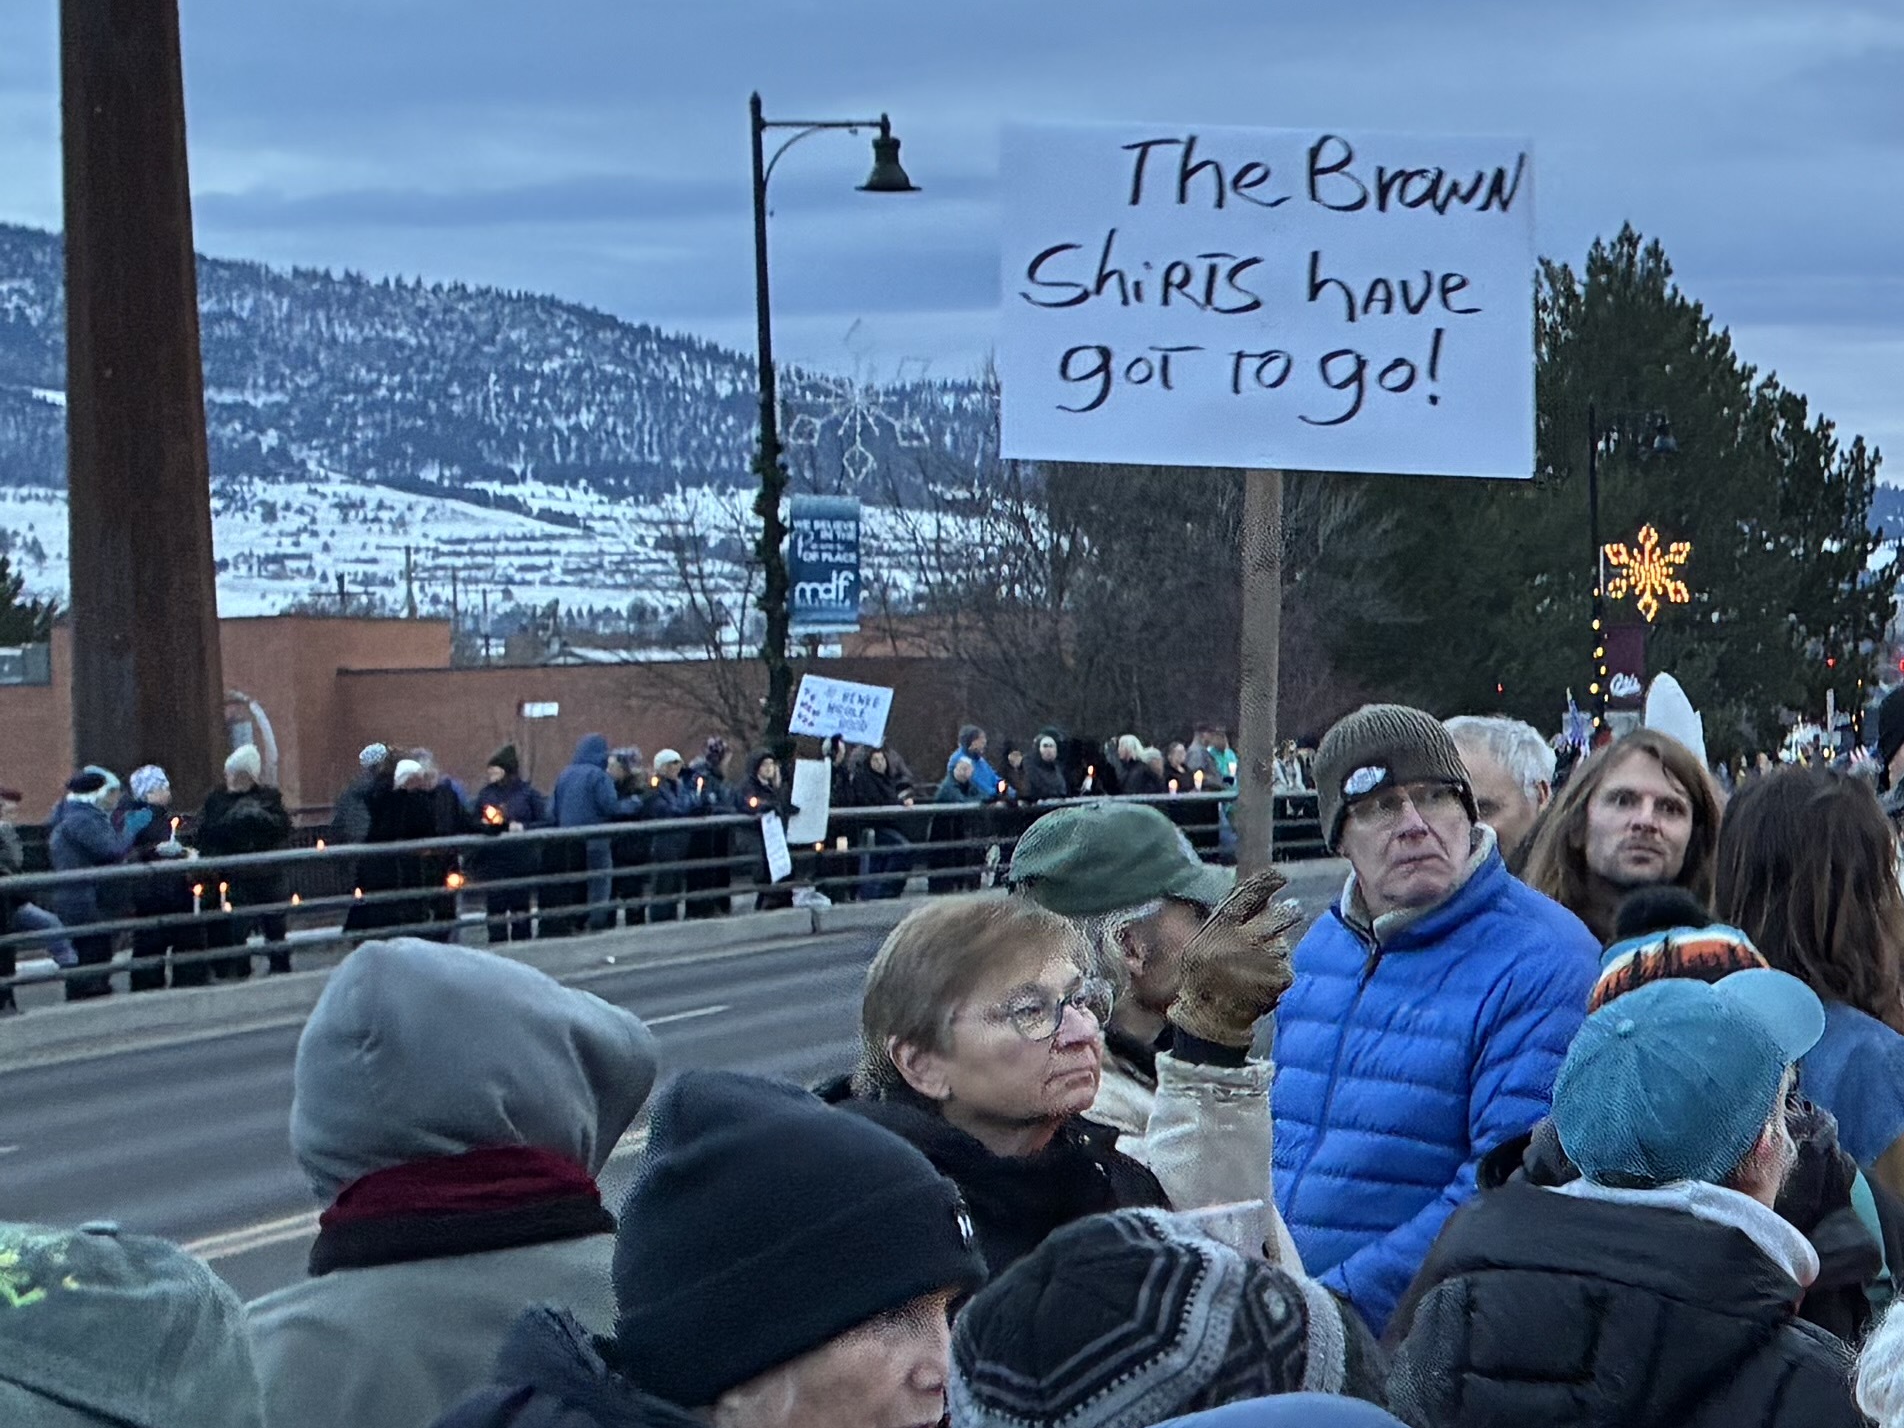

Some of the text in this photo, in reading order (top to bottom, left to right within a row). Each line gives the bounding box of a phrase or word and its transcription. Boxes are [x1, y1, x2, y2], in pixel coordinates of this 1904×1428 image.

[1121, 134, 1291, 209] The
[1298, 326, 1445, 427] go!
[794, 569, 854, 604] mdf
